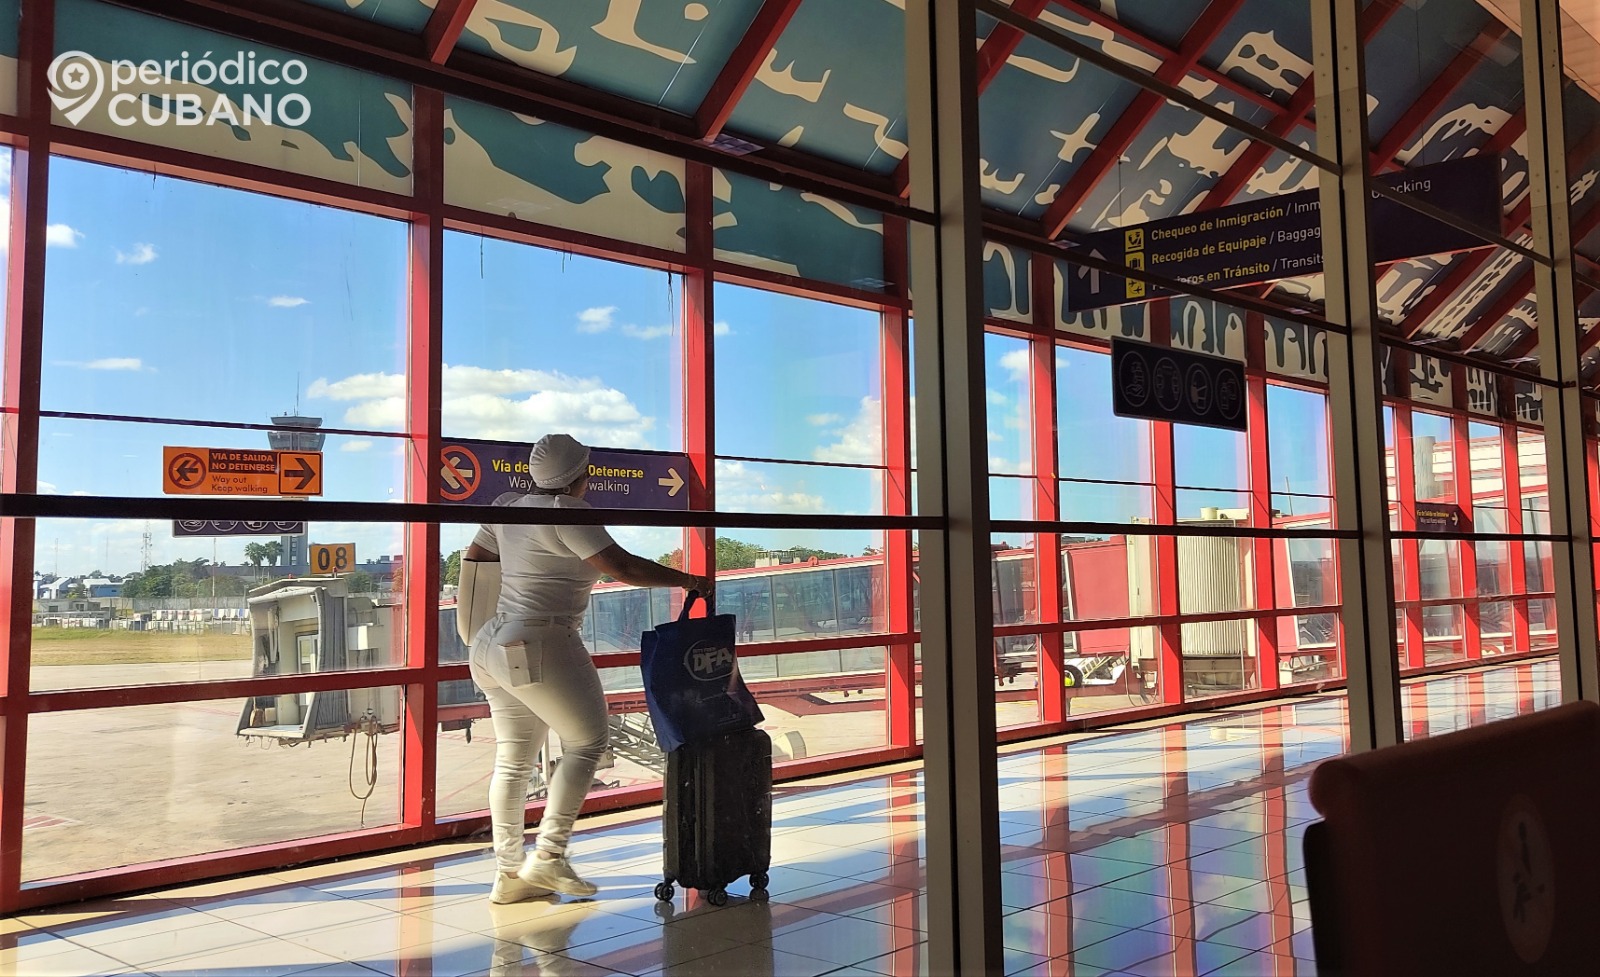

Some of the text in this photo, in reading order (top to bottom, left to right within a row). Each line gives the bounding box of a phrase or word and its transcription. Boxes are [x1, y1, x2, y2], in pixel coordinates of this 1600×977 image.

[1151, 224, 1197, 242] Chequeo
[1200, 220, 1213, 231] de
[1215, 205, 1283, 229] Inmigración
[1285, 203, 1291, 216] /
[1294, 200, 1321, 214] Imm
[1151, 226, 1321, 265] Recogida de Equipaje / Baggag
[1207, 271, 1221, 282] en
[1223, 262, 1270, 279] Tránsito
[1272, 259, 1278, 272] /
[211, 452, 274, 462] VIA DE SALIDA
[211, 462, 276, 472] NO DETENERSE
[491, 459, 644, 479] Vía de Detenerse
[211, 484, 268, 494] Keep walking
[212, 475, 231, 484] Way
[508, 475, 630, 495] Way walking
[317, 546, 348, 570] 08
[692, 647, 733, 674] DFA
